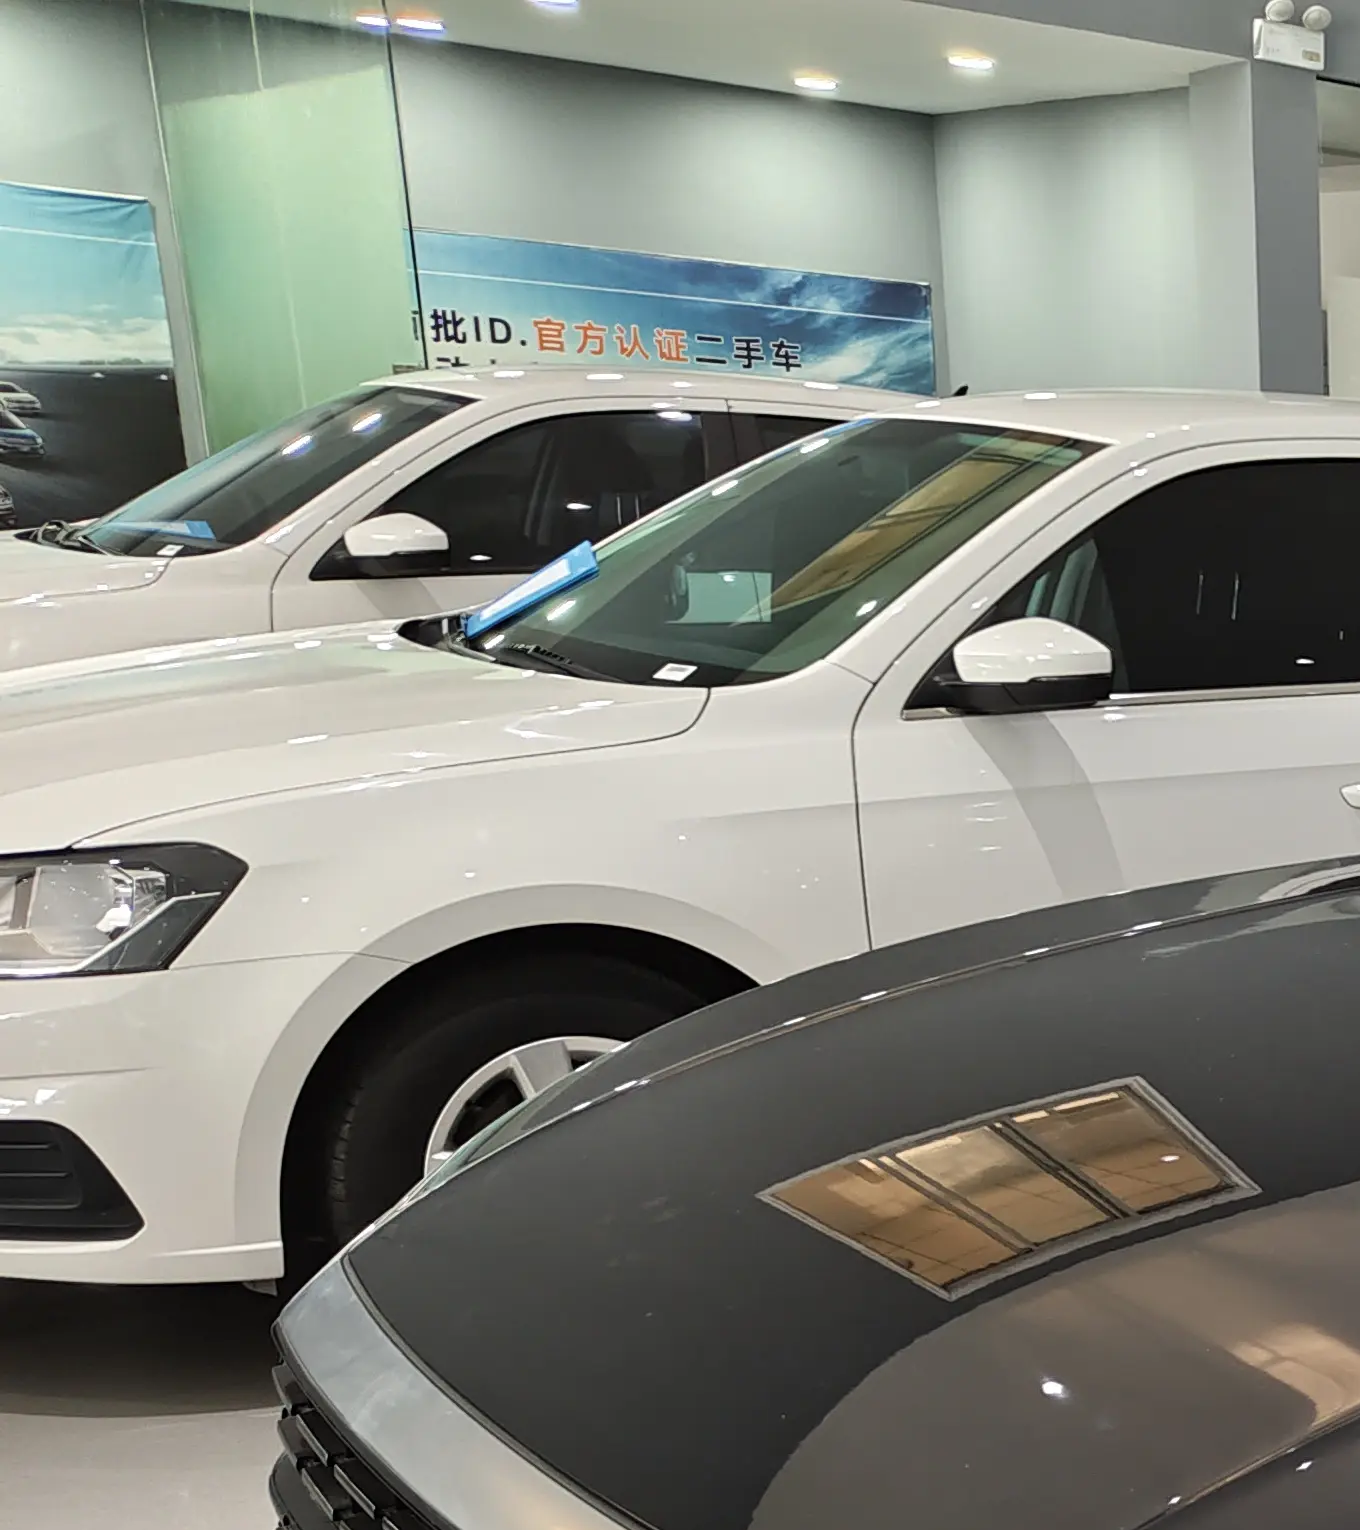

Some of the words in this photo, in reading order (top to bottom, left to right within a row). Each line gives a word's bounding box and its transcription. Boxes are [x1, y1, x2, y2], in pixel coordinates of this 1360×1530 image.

[411, 308, 802, 372] 批ID.官方认证二手车
